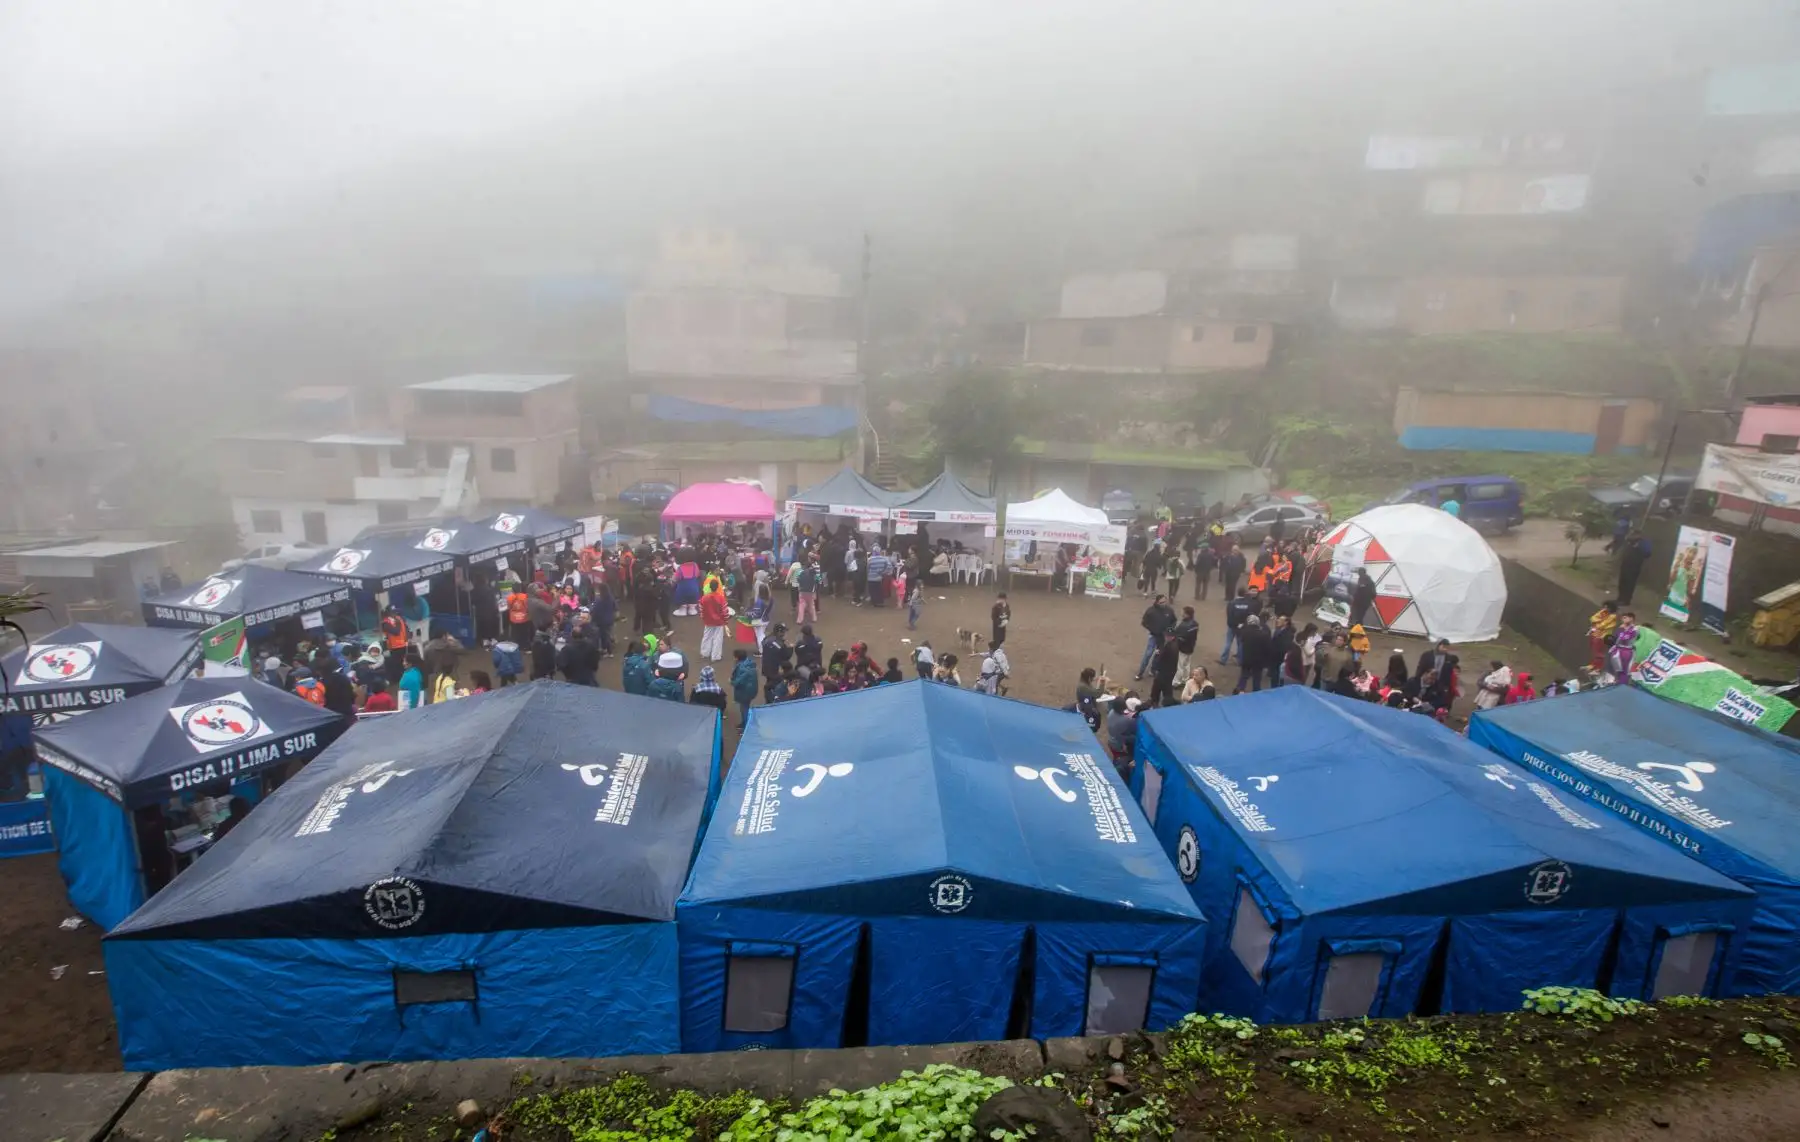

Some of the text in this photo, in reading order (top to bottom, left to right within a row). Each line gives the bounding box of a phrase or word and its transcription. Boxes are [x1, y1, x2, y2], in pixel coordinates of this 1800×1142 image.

[184, 611, 204, 623] LIMA
[206, 613, 222, 625] SUR
[24, 695, 36, 710] II
[41, 691, 86, 708] LIMA
[89, 688, 126, 704] SUR
[170, 732, 317, 791] DISA II LIMA SUR
[766, 784, 784, 799] de
[1081, 779, 1116, 842] Ministerio
[1523, 751, 1575, 788] DIRECCION
[1575, 780, 1593, 796] DE
[1592, 788, 1629, 816] SALUD
[1641, 815, 1673, 840] LIMA
[1674, 832, 1701, 854] SUR
[1652, 780, 1676, 796] de
[1675, 795, 1733, 826] Salud
[30, 820, 46, 836] DE
[760, 799, 781, 833] Salud
[1235, 790, 1249, 804] de
[1246, 803, 1276, 832] Salud
